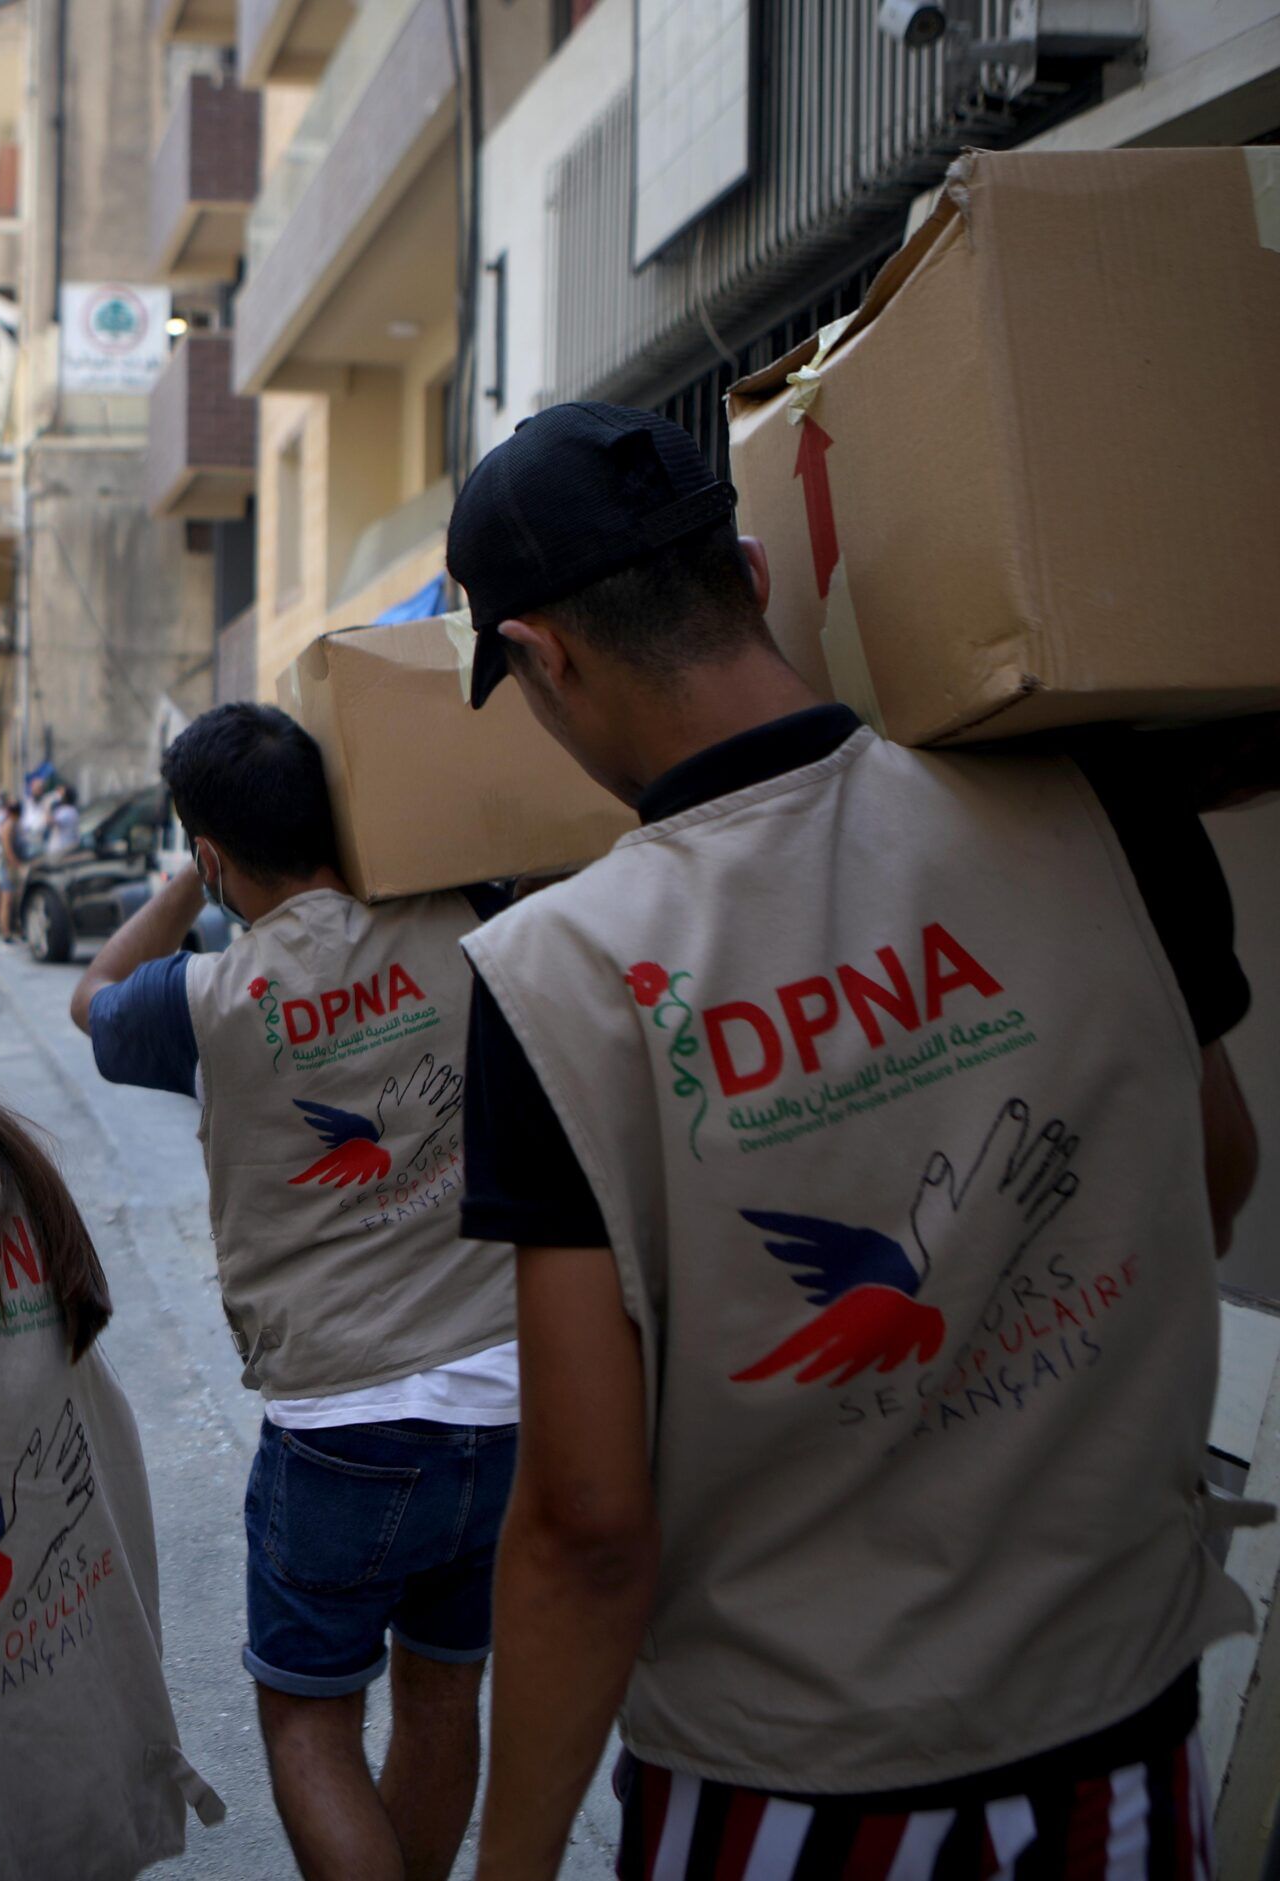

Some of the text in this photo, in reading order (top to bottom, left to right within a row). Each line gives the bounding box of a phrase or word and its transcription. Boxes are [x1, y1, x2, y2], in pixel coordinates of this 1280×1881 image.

[282, 963, 426, 1045] DPNA
[703, 922, 1004, 1097] DPNA
[950, 1009, 1026, 1047] جمعية
[884, 1033, 948, 1077] التنمية
[339, 1134, 459, 1215] SECOURS
[360, 1168, 463, 1232] FRANÇAI
[377, 1151, 464, 1210] POPULA
